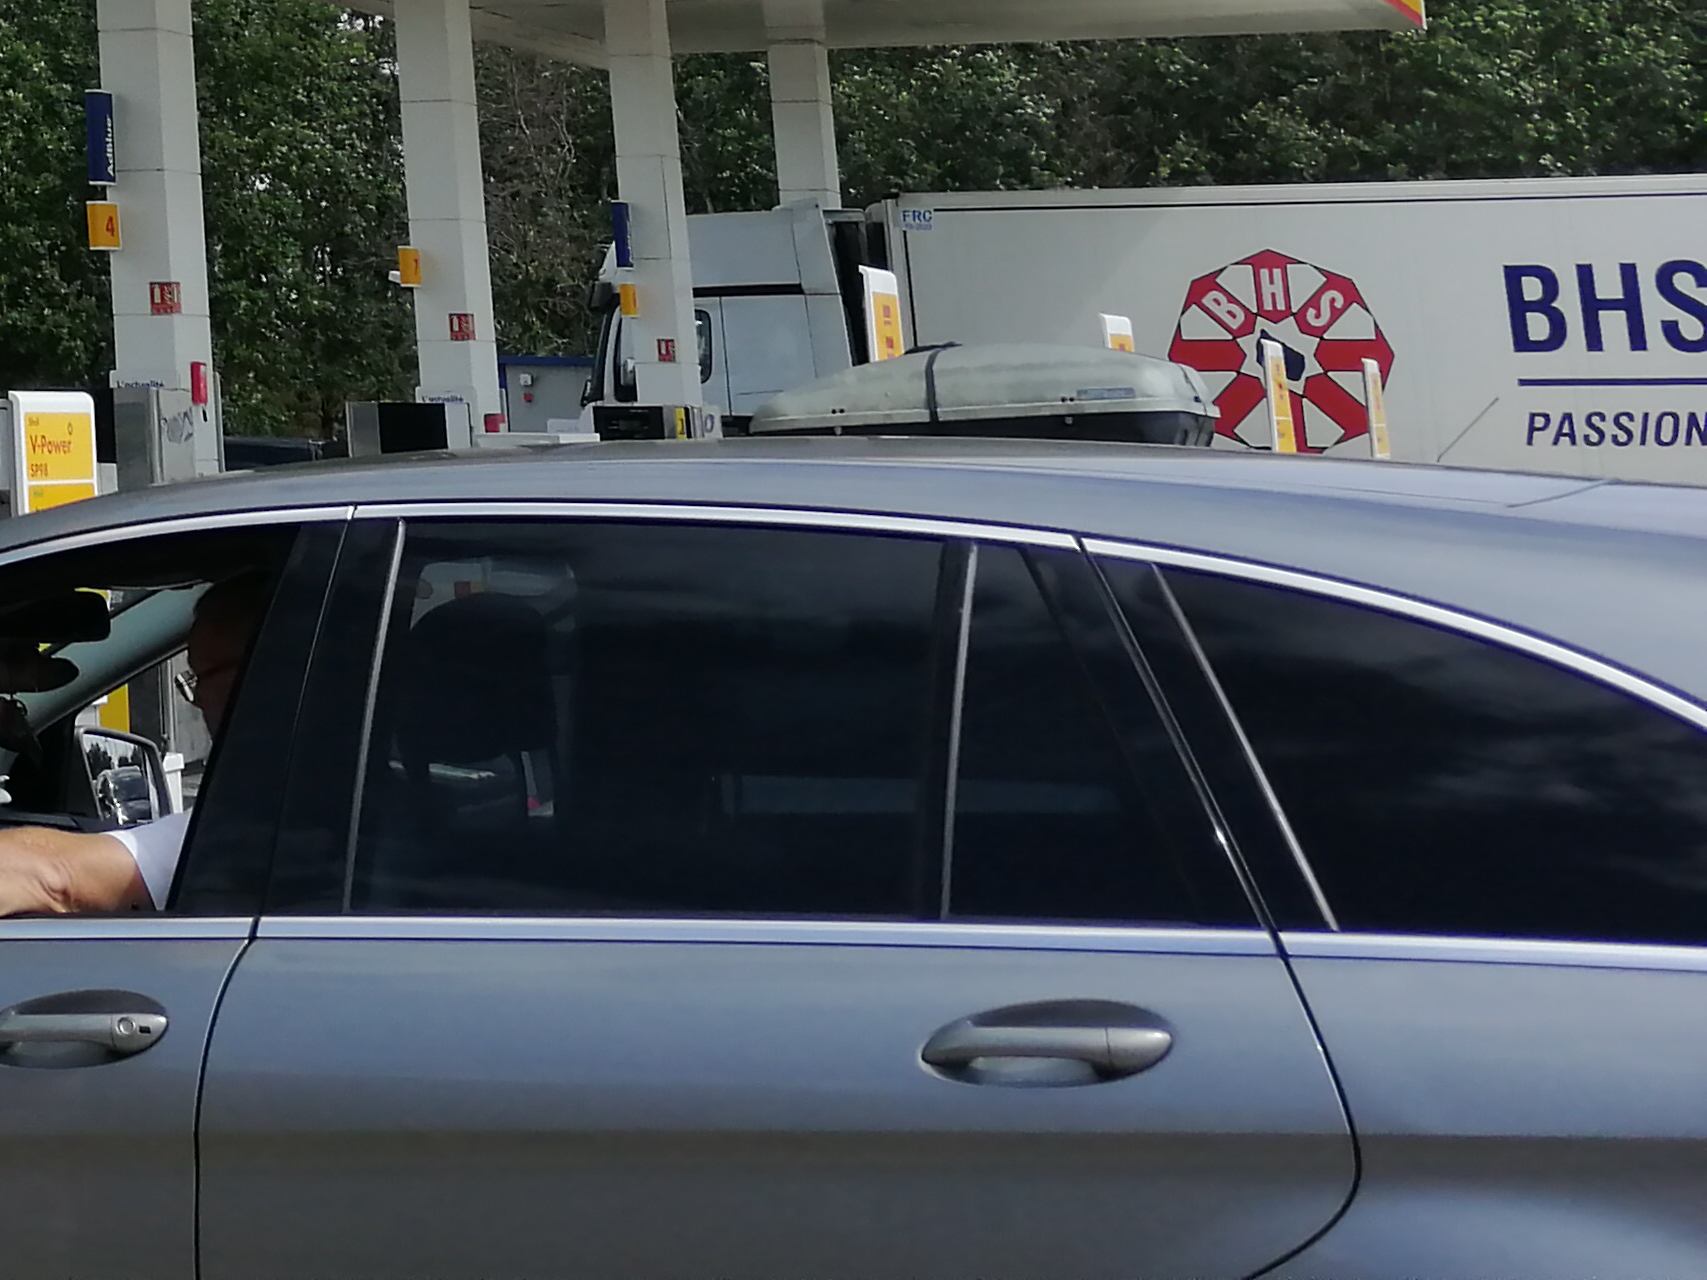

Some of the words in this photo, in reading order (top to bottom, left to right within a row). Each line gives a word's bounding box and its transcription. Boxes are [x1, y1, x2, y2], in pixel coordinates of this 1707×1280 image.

[105, 216, 115, 238] 4
[1201, 268, 1345, 330] BHS
[1502, 258, 1707, 354] BHS
[29, 434, 72, 455] V-Power
[1525, 410, 1707, 447] PASSION
